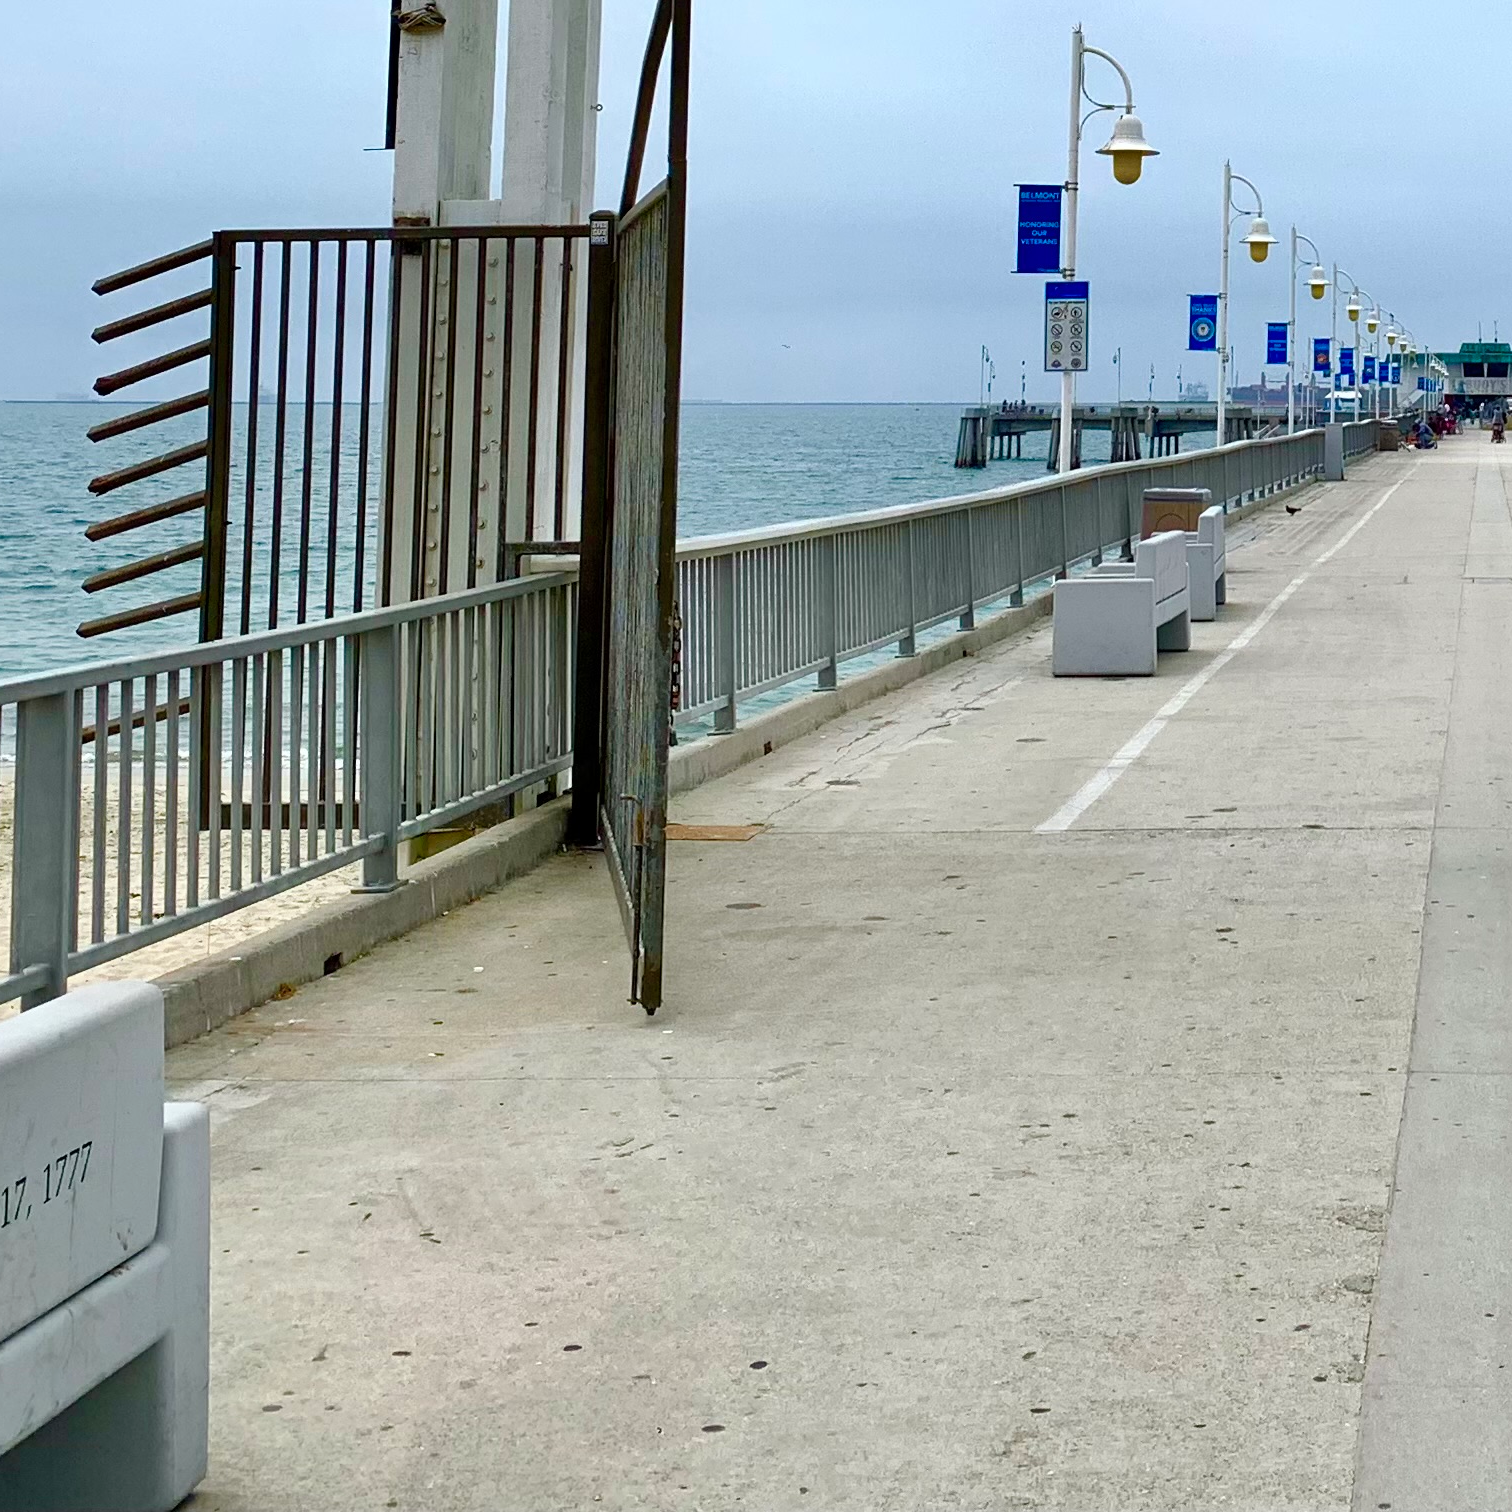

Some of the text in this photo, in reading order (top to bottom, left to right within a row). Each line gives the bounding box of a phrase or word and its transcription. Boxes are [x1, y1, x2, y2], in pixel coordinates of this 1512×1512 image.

[1020, 192, 1060, 200] BELMONT
[1031, 229, 1048, 237] OUR
[1, 1140, 93, 1228] 17, 1777
